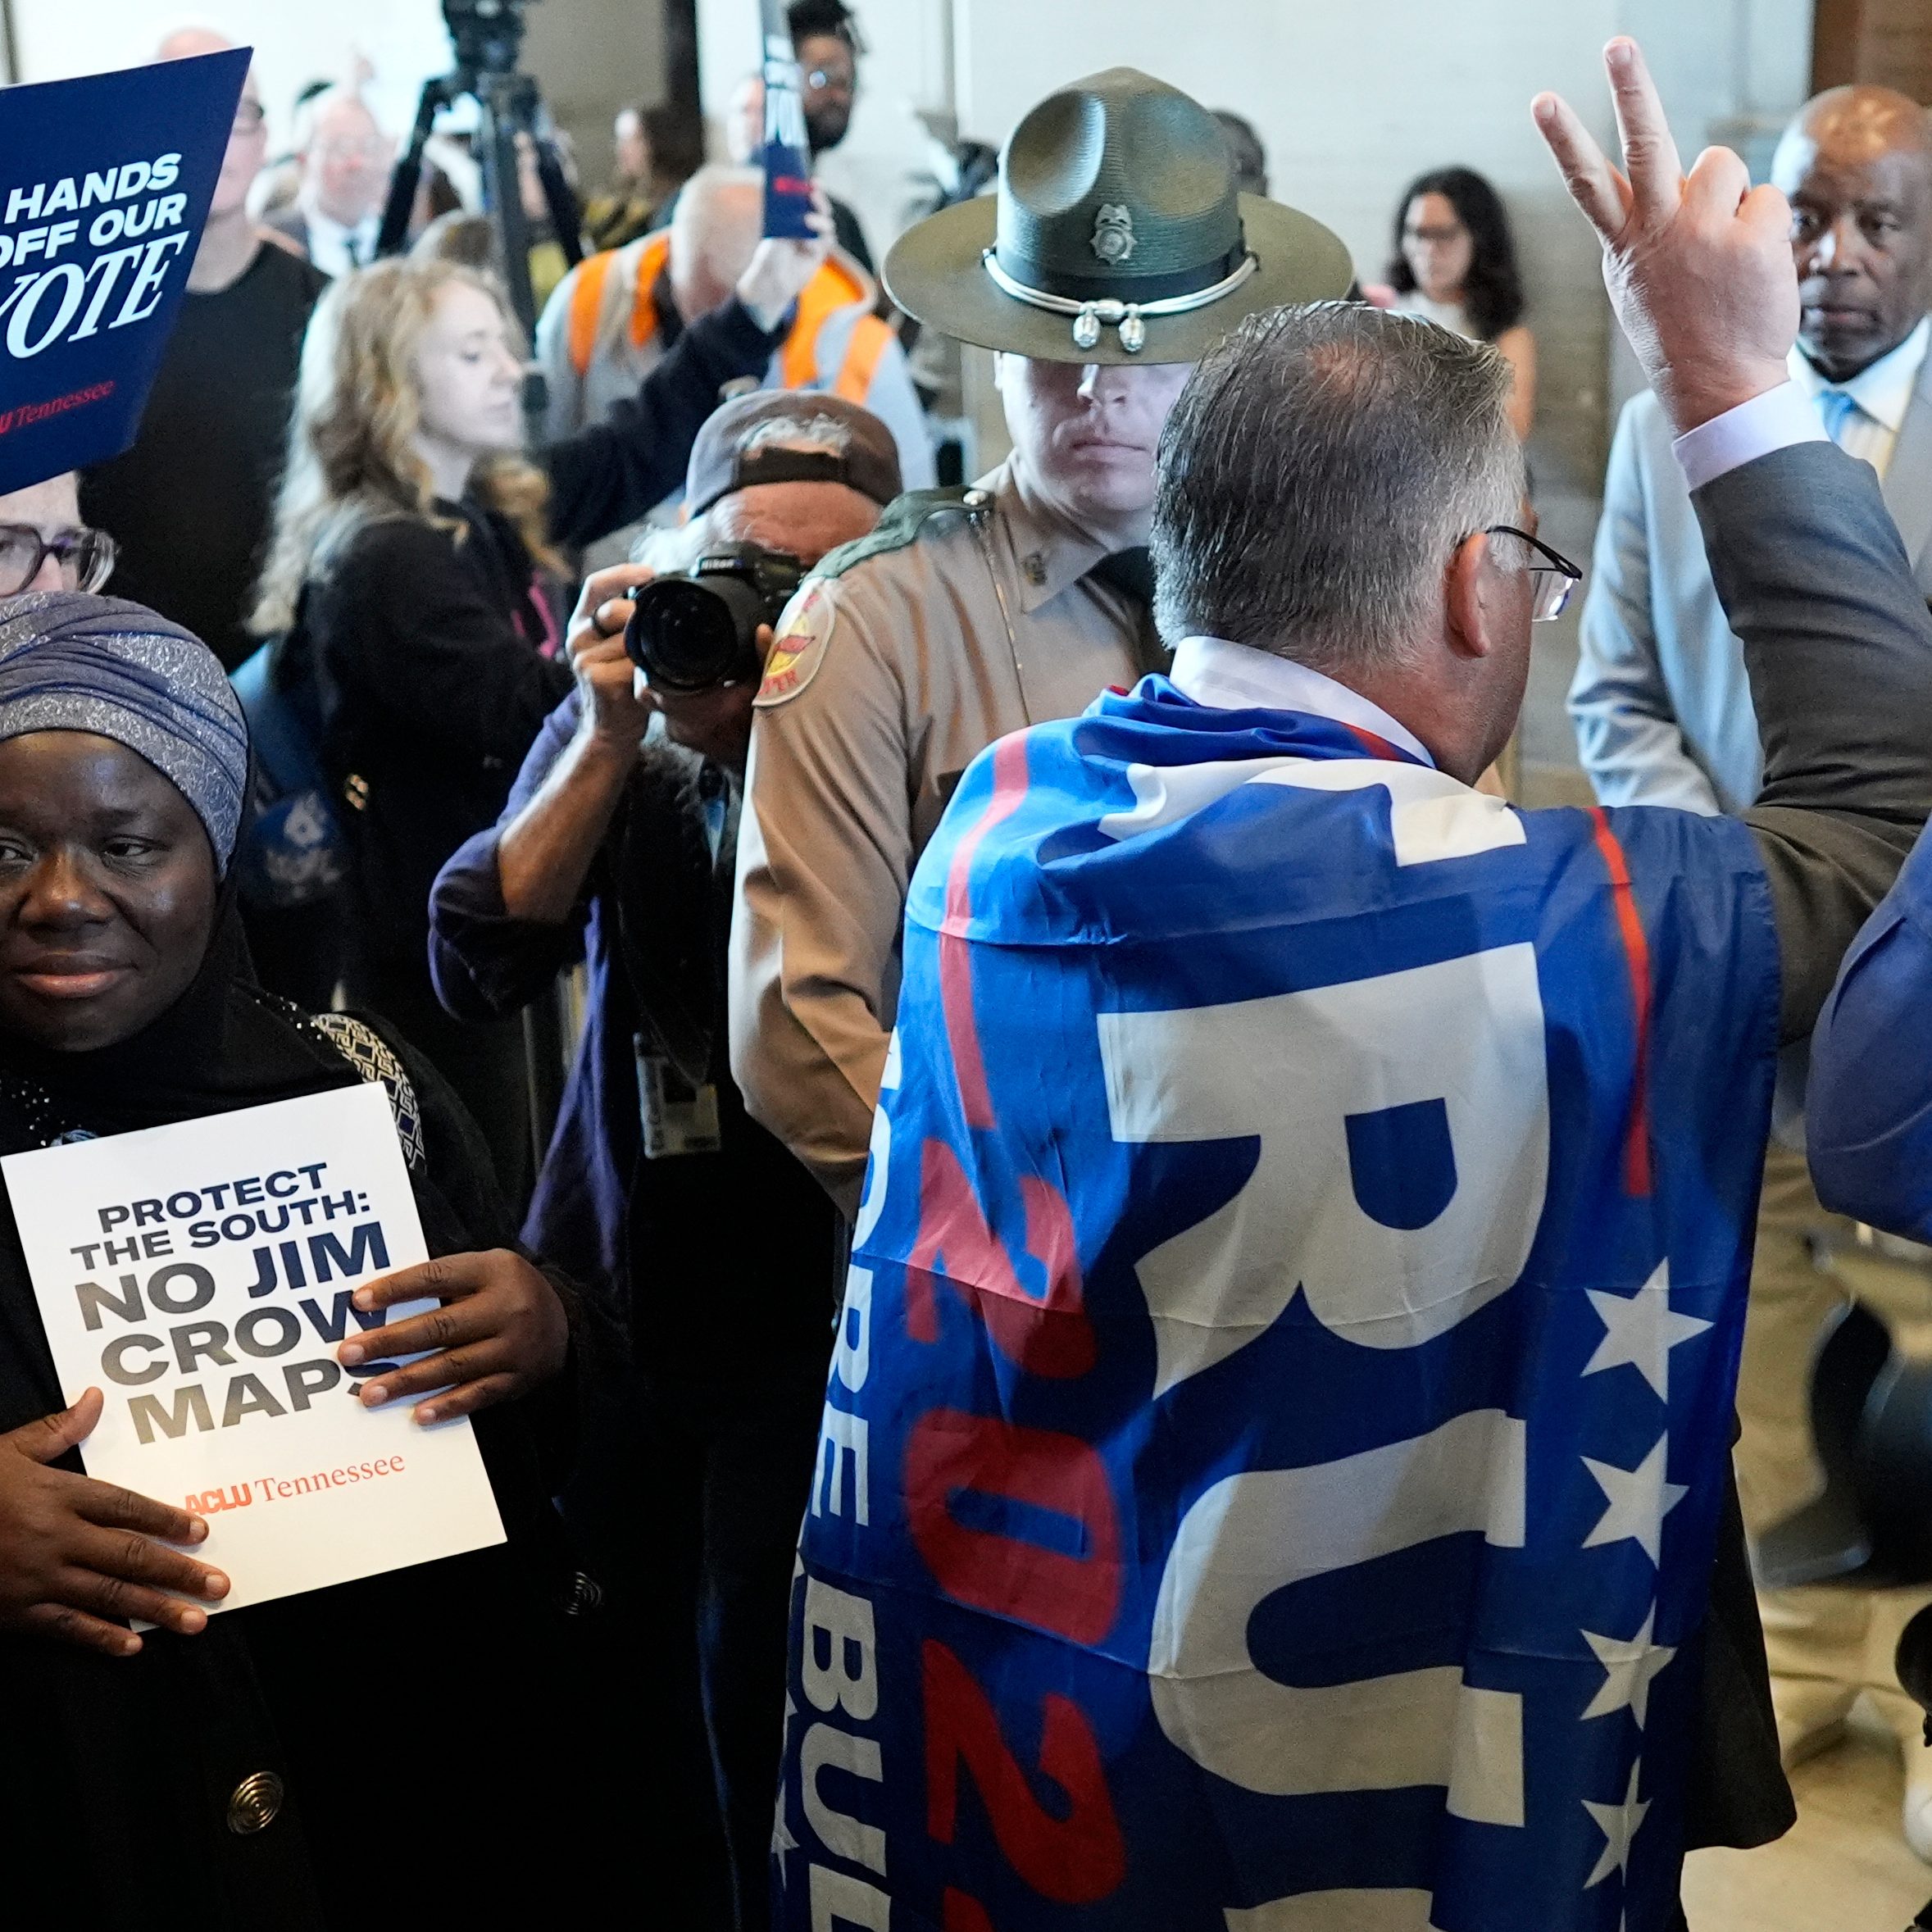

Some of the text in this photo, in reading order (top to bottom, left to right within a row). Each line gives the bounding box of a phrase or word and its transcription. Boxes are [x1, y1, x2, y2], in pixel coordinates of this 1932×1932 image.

[4, 152, 182, 224] HANDS
[89, 193, 187, 246] OUR
[15, 380, 116, 427] Tennessee
[70, 1190, 370, 1271] THE SOUTH:
[98, 1161, 327, 1233] PROTECT
[75, 1221, 391, 1331] NO JIM
[1096, 757, 1549, 1932] TRU
[184, 1455, 406, 1516] ACLU Tennessee
